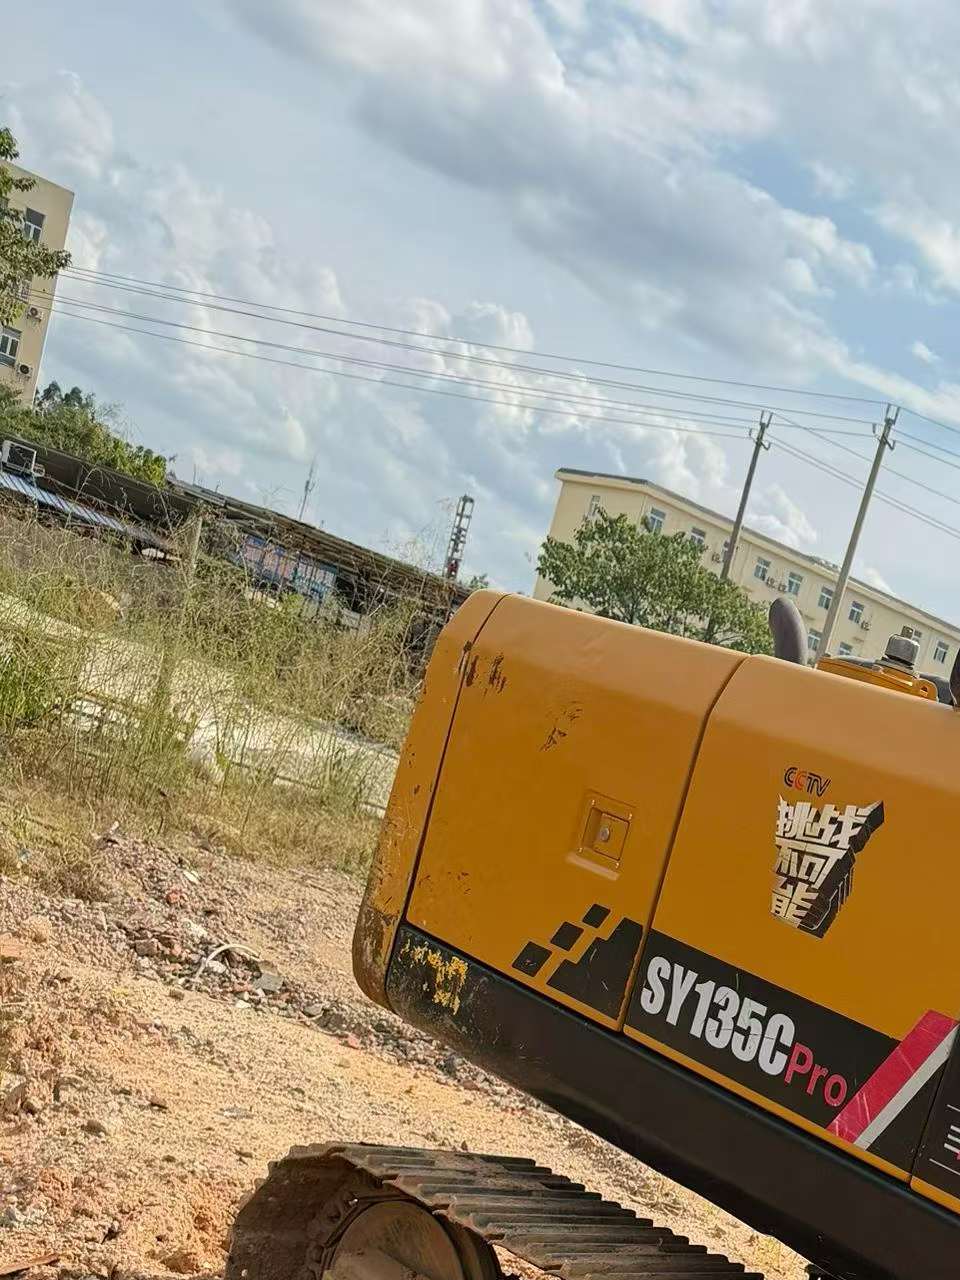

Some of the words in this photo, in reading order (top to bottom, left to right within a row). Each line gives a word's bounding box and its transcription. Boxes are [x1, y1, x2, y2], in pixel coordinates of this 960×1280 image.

[784, 766, 832, 797] CCTV
[776, 795, 883, 850] 挑战
[770, 876, 820, 929] 能
[640, 956, 795, 1076] SY135C
[784, 1042, 848, 1107] Pro
